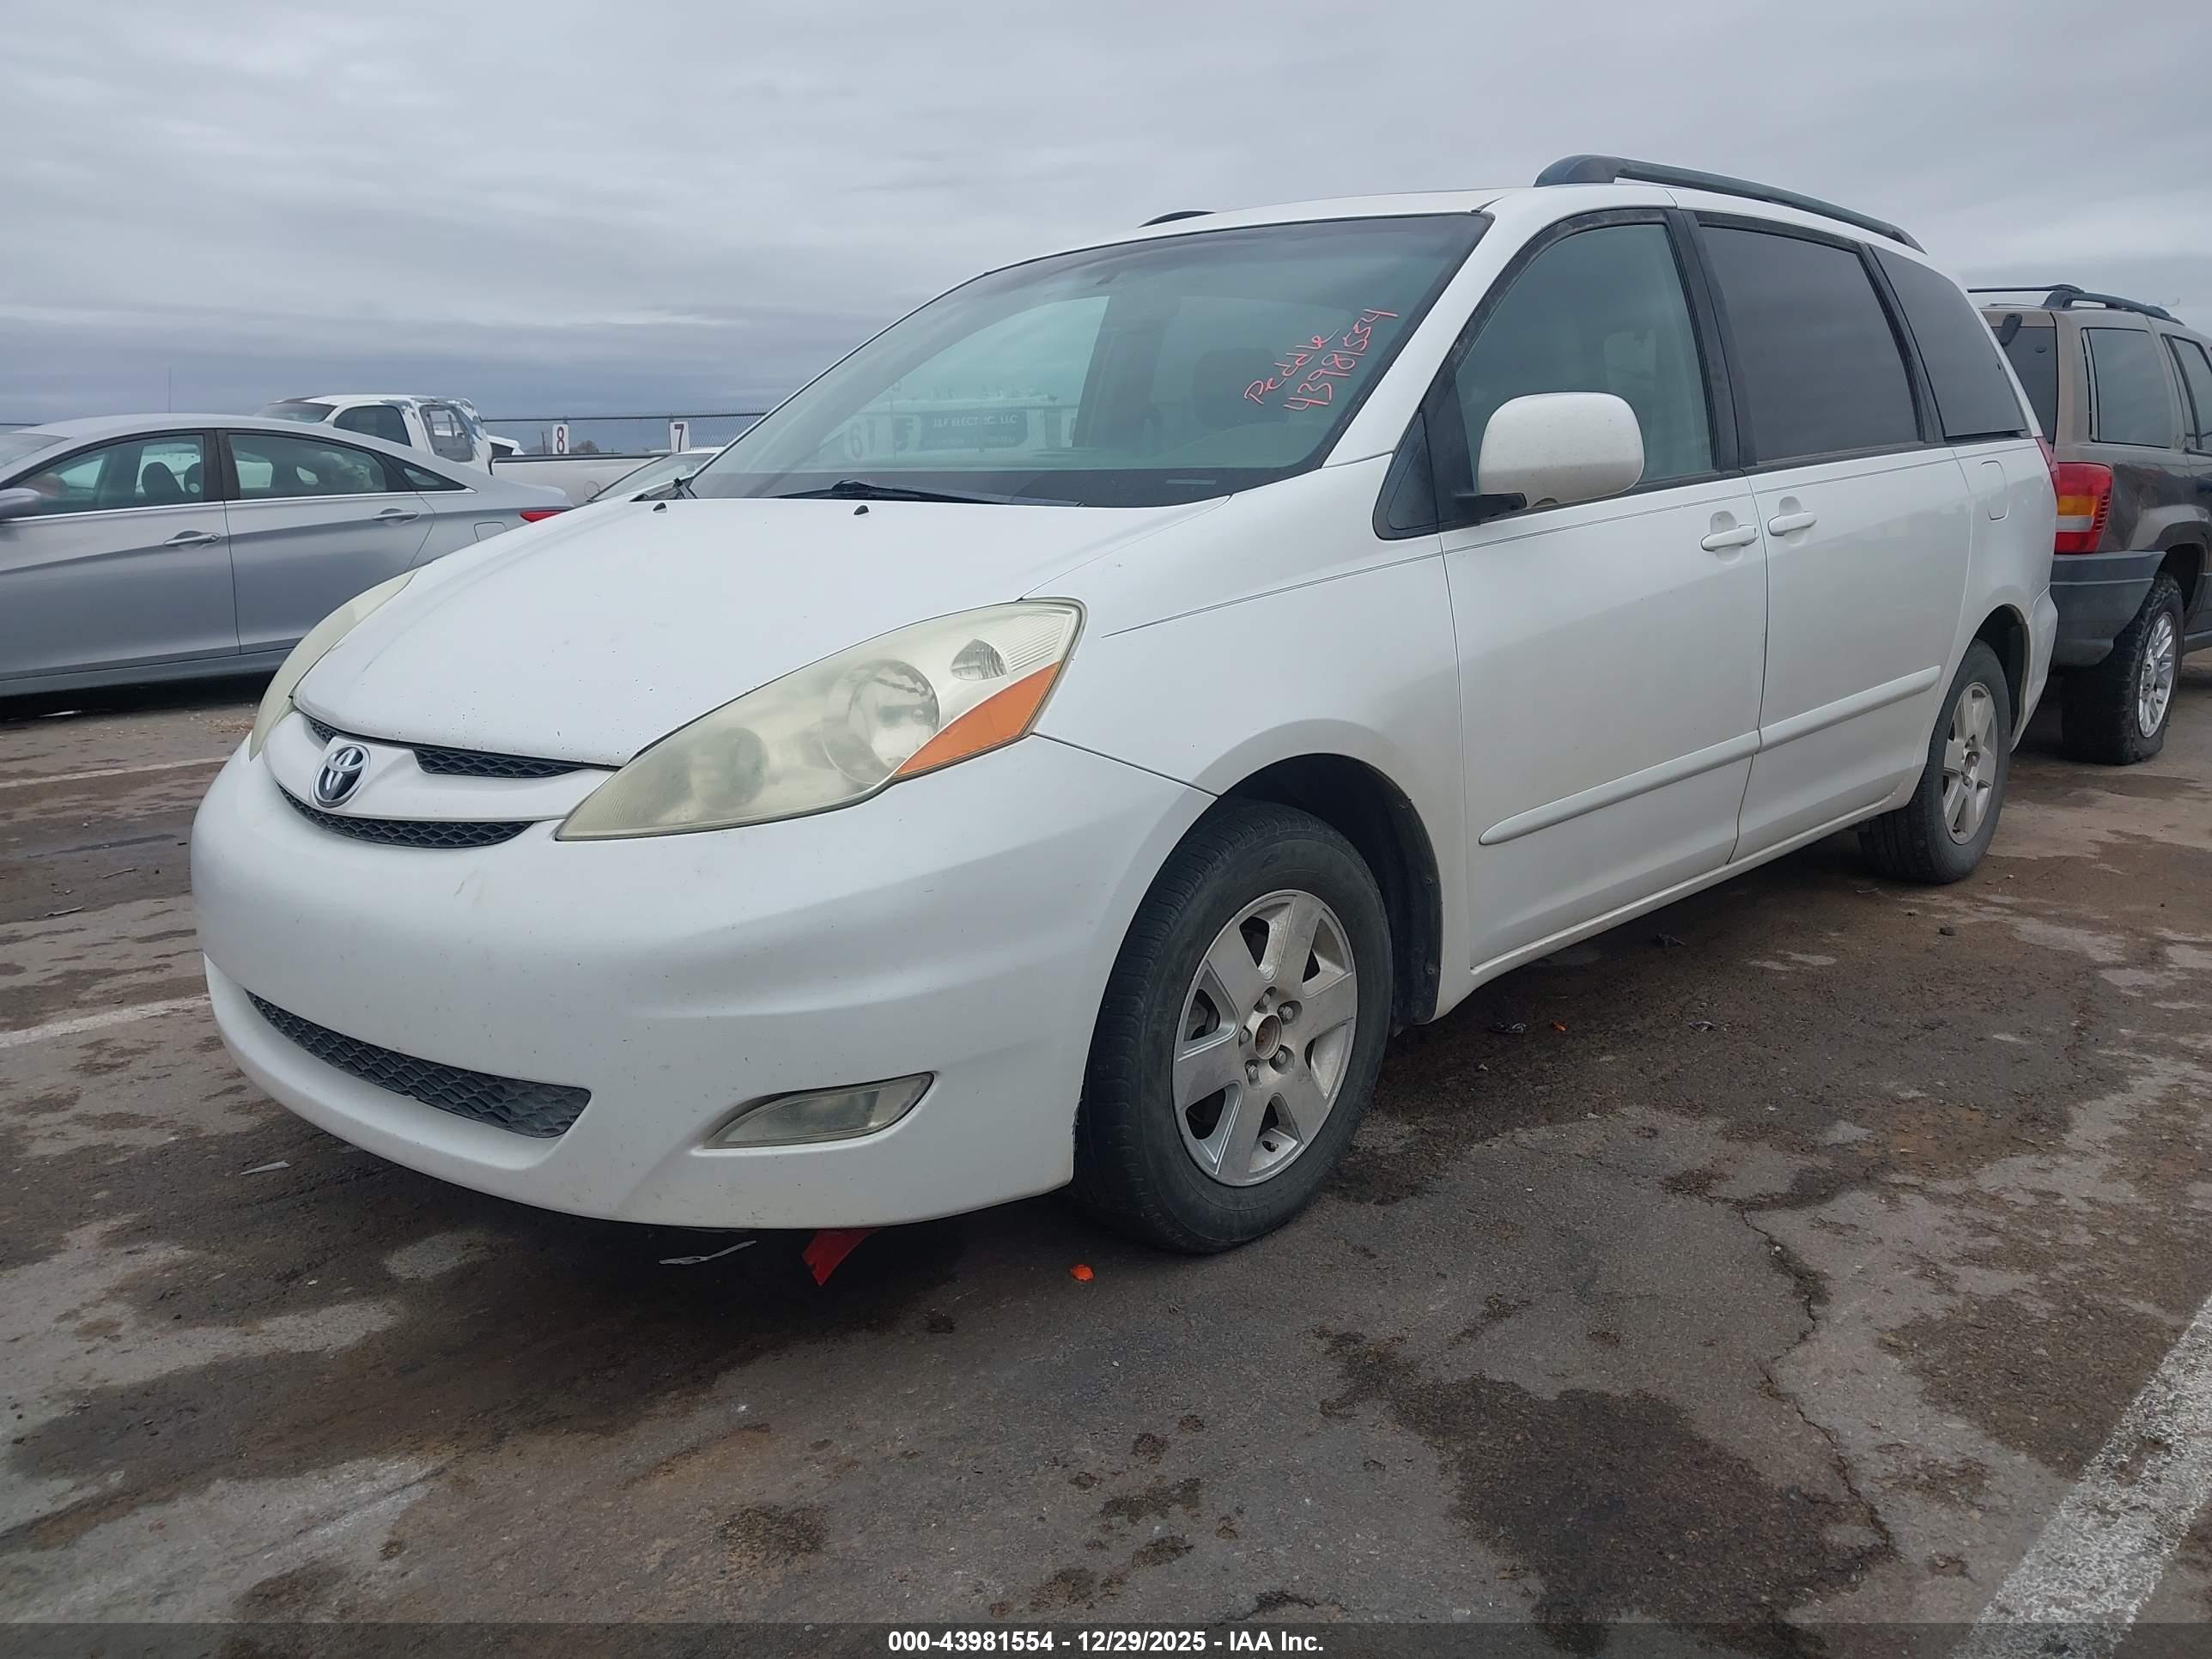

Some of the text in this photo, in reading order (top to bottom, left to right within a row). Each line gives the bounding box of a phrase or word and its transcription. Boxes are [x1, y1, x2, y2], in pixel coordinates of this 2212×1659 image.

[1244, 329, 1340, 405] Peddle
[1283, 308, 1399, 410] 43981554
[1000, 414, 1018, 424] LLC
[556, 426, 564, 454] 8
[674, 423, 684, 453] 7
